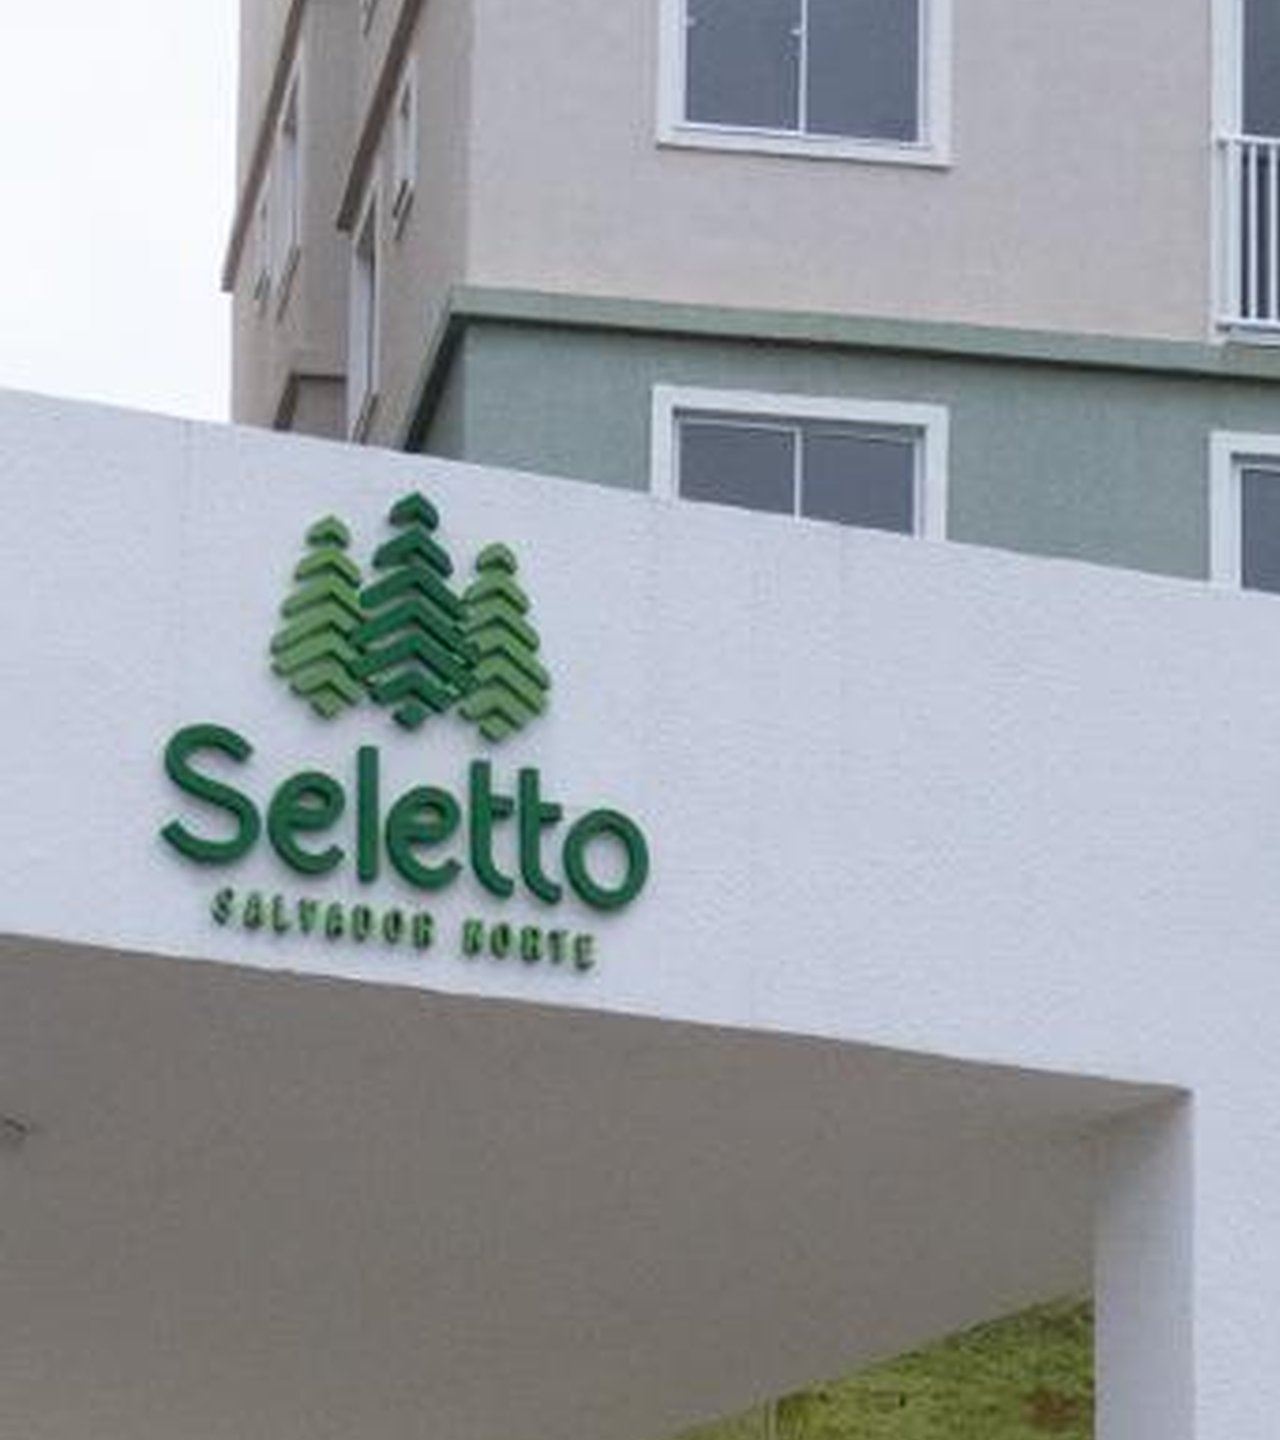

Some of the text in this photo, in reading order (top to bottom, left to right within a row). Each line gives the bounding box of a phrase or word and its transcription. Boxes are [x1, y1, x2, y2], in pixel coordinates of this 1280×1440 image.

[160, 723, 649, 911] Seletto
[210, 887, 598, 971] SALVADOR NORTE
